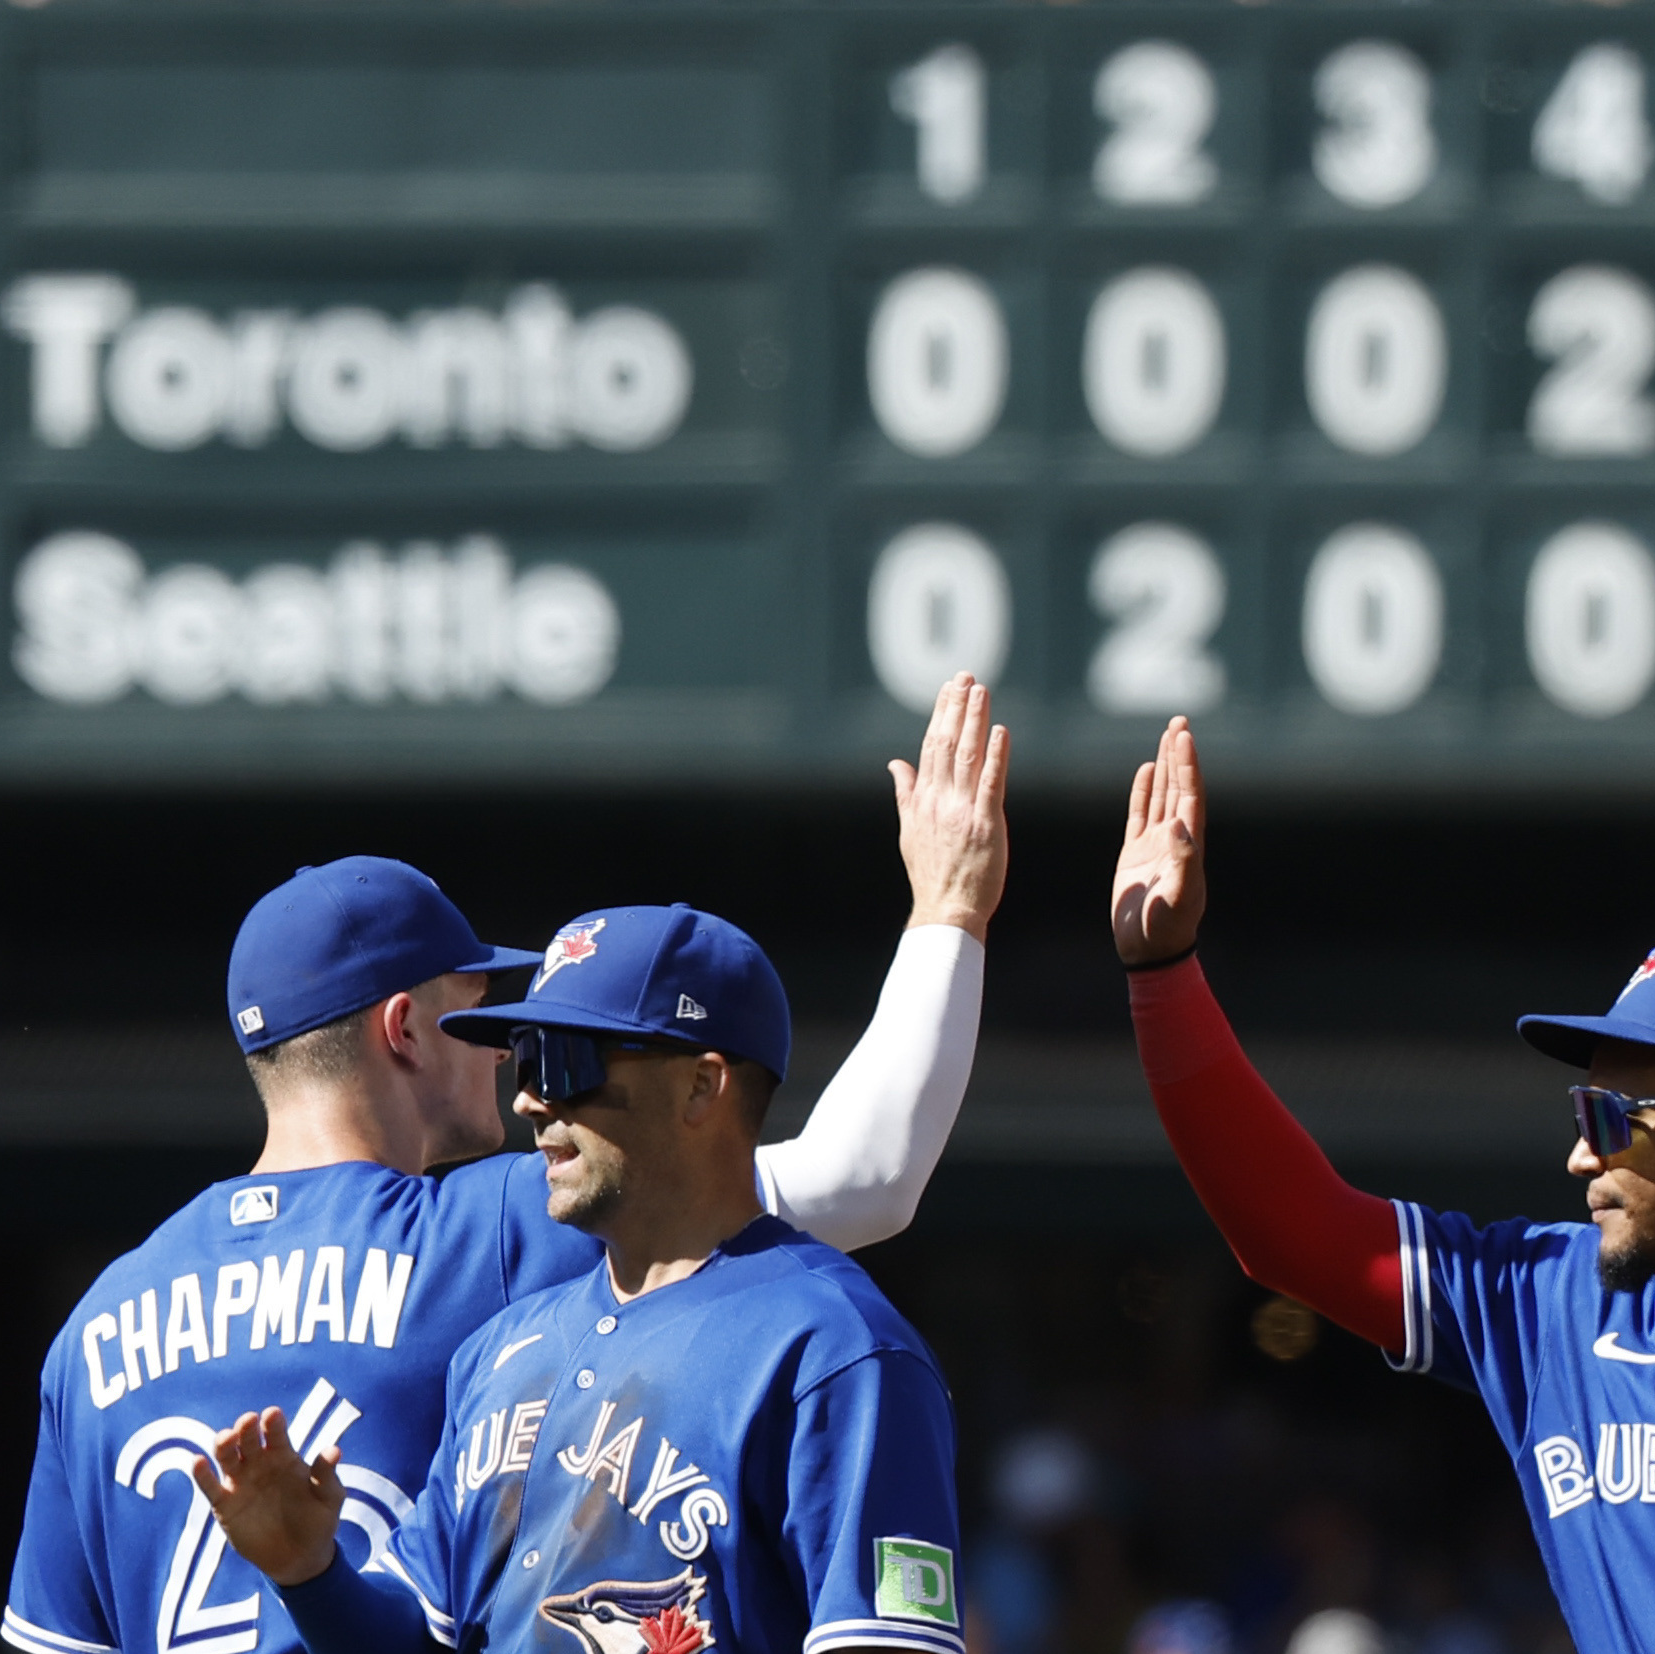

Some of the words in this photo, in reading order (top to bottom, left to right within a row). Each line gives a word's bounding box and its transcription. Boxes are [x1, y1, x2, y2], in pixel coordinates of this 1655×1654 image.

[889, 41, 987, 203] 1
[1093, 38, 1217, 204] 2
[1312, 37, 1436, 207] 3
[3, 272, 691, 449] Toronto
[865, 262, 1009, 458] 0
[1082, 262, 1229, 458] 0
[1304, 262, 1448, 458] 0
[12, 531, 618, 704] Seattle
[865, 520, 1012, 716] 0
[1085, 520, 1227, 716] 2
[1301, 520, 1446, 716] 0
[82, 1245, 414, 1410] CHAPMAN
[453, 1398, 549, 1515] UE
[557, 1399, 730, 1561] JAYS
[887, 1553, 948, 1607] TD
